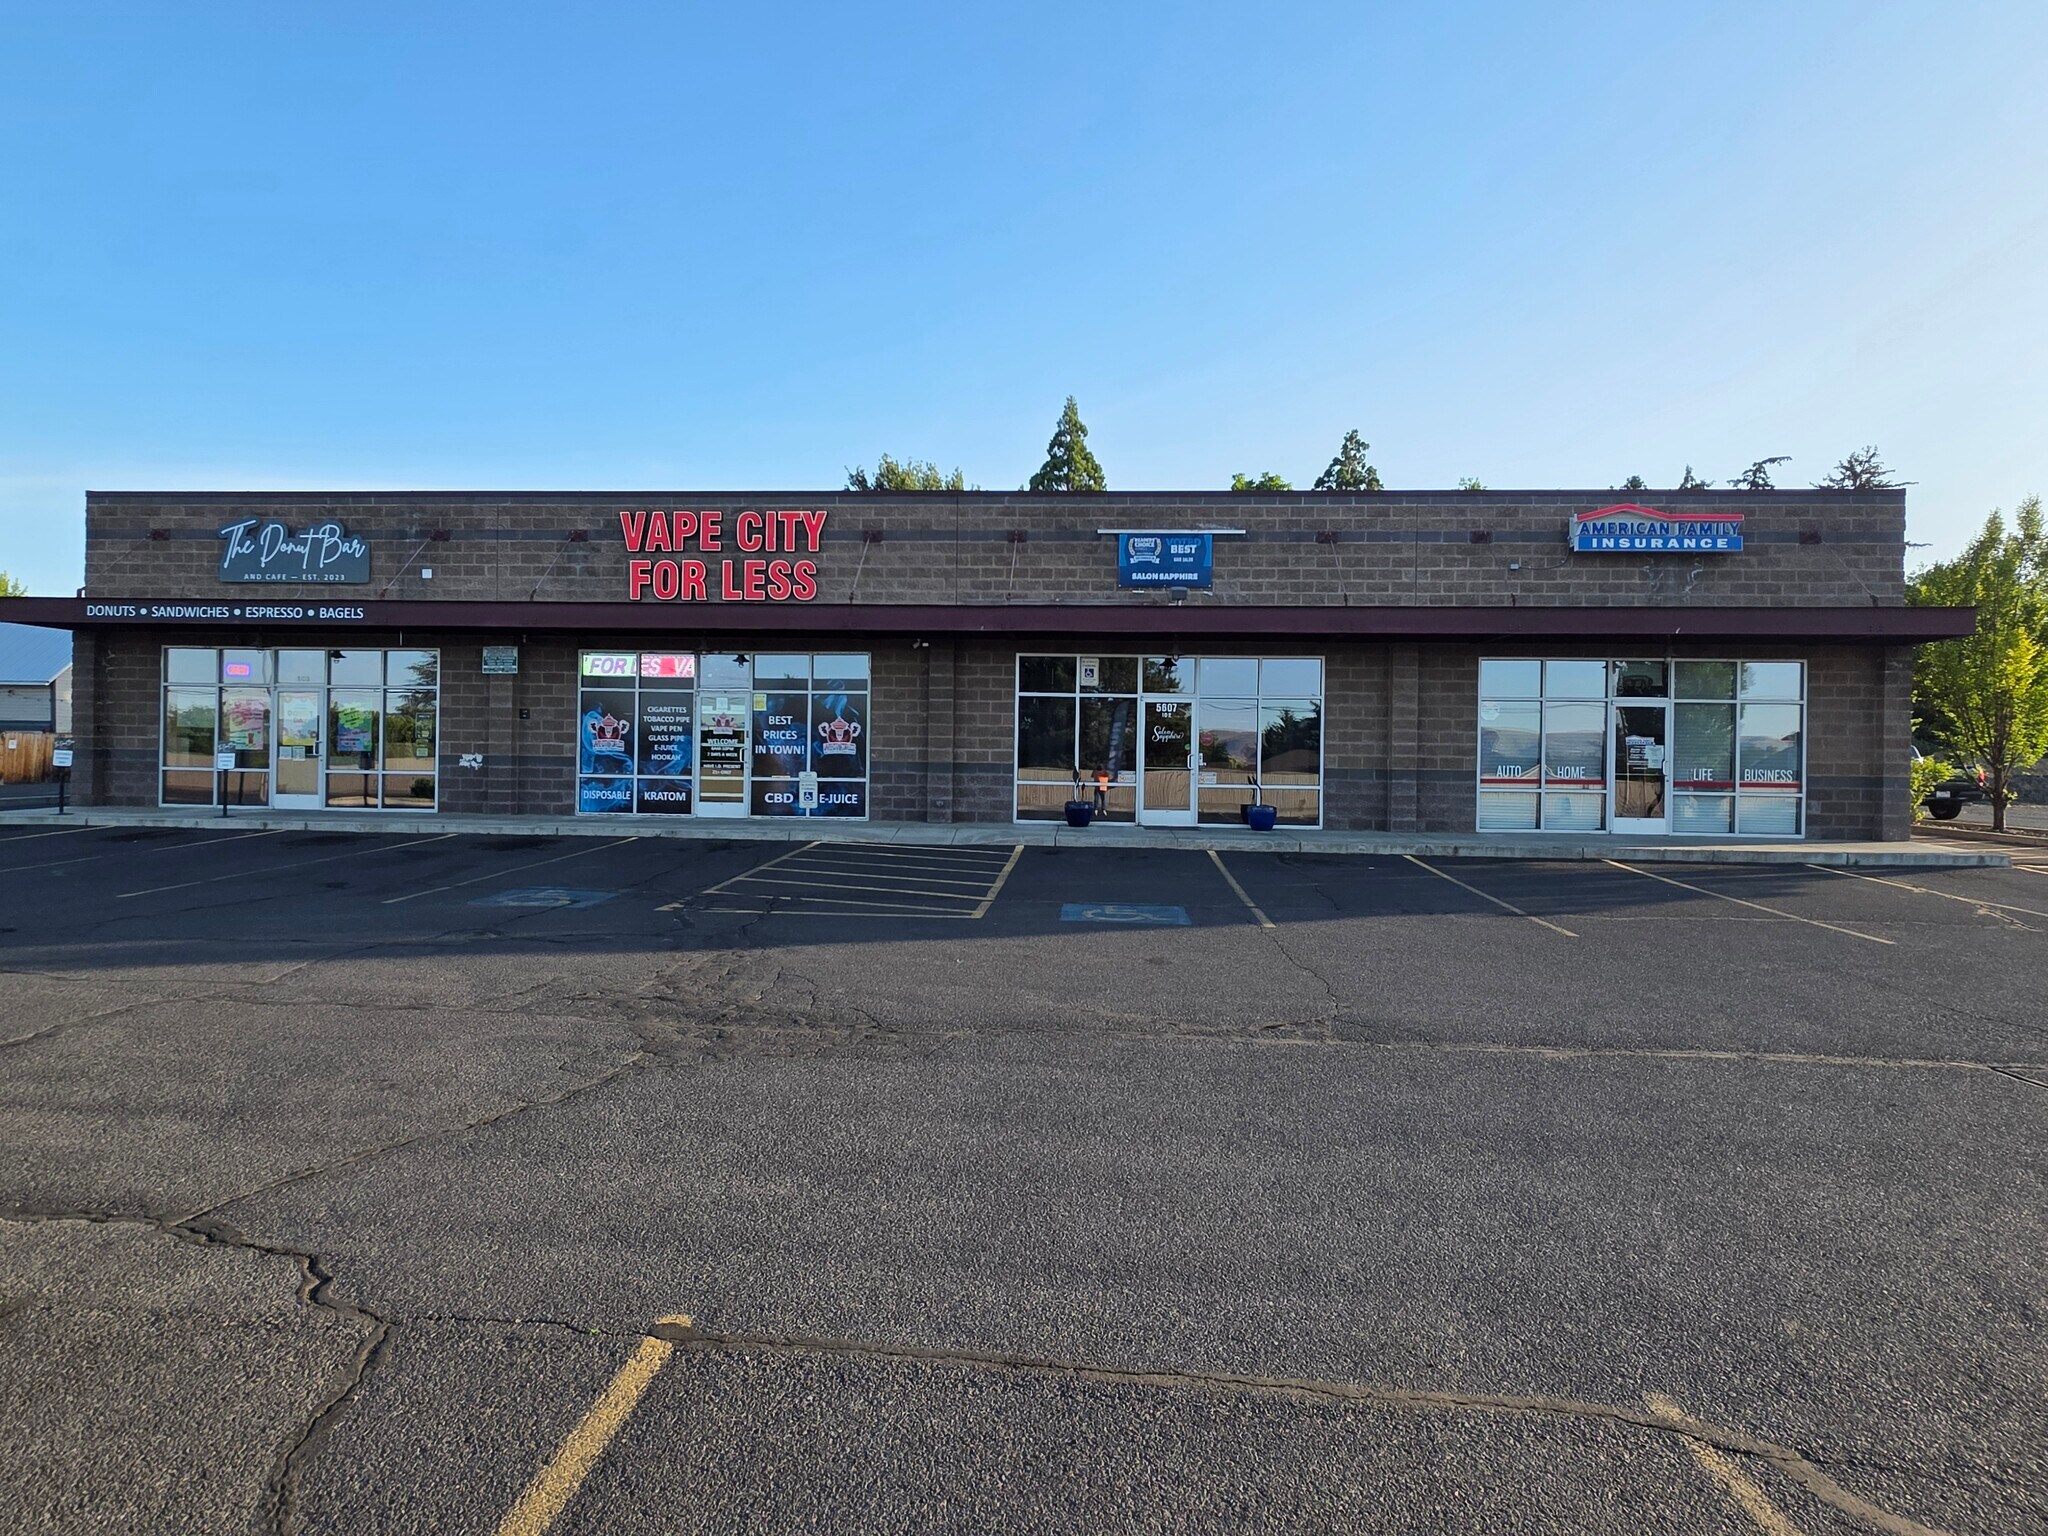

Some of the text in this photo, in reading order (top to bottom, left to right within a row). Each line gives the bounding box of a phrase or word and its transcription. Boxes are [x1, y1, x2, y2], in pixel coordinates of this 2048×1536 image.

[620, 511, 827, 552] VAPE CITY
[1580, 522, 1740, 536] AMERICAN FAMILY
[221, 520, 366, 569] The Donut Bar
[1165, 538, 1202, 546] VOTED
[1592, 538, 1728, 548] INSURANCE
[1170, 544, 1197, 554] BEST
[630, 560, 816, 600] FOR LESS
[86, 605, 364, 619] DONUTS SANDWICHES ESPRESSO BAGELS
[590, 656, 628, 674] FOR
[769, 716, 793, 725] BEST
[763, 730, 797, 739] PRICES
[755, 745, 804, 754] IN TOWN!
[1496, 765, 1522, 778] AUTO
[1557, 766, 1586, 779] HOME
[1693, 768, 1713, 781] LIFE
[1744, 769, 1793, 782] BUSINESS
[584, 790, 631, 800] DISPOSABLE
[644, 792, 686, 801] KRATOM
[764, 793, 794, 804] CBD
[819, 794, 858, 804] E-JUICE
